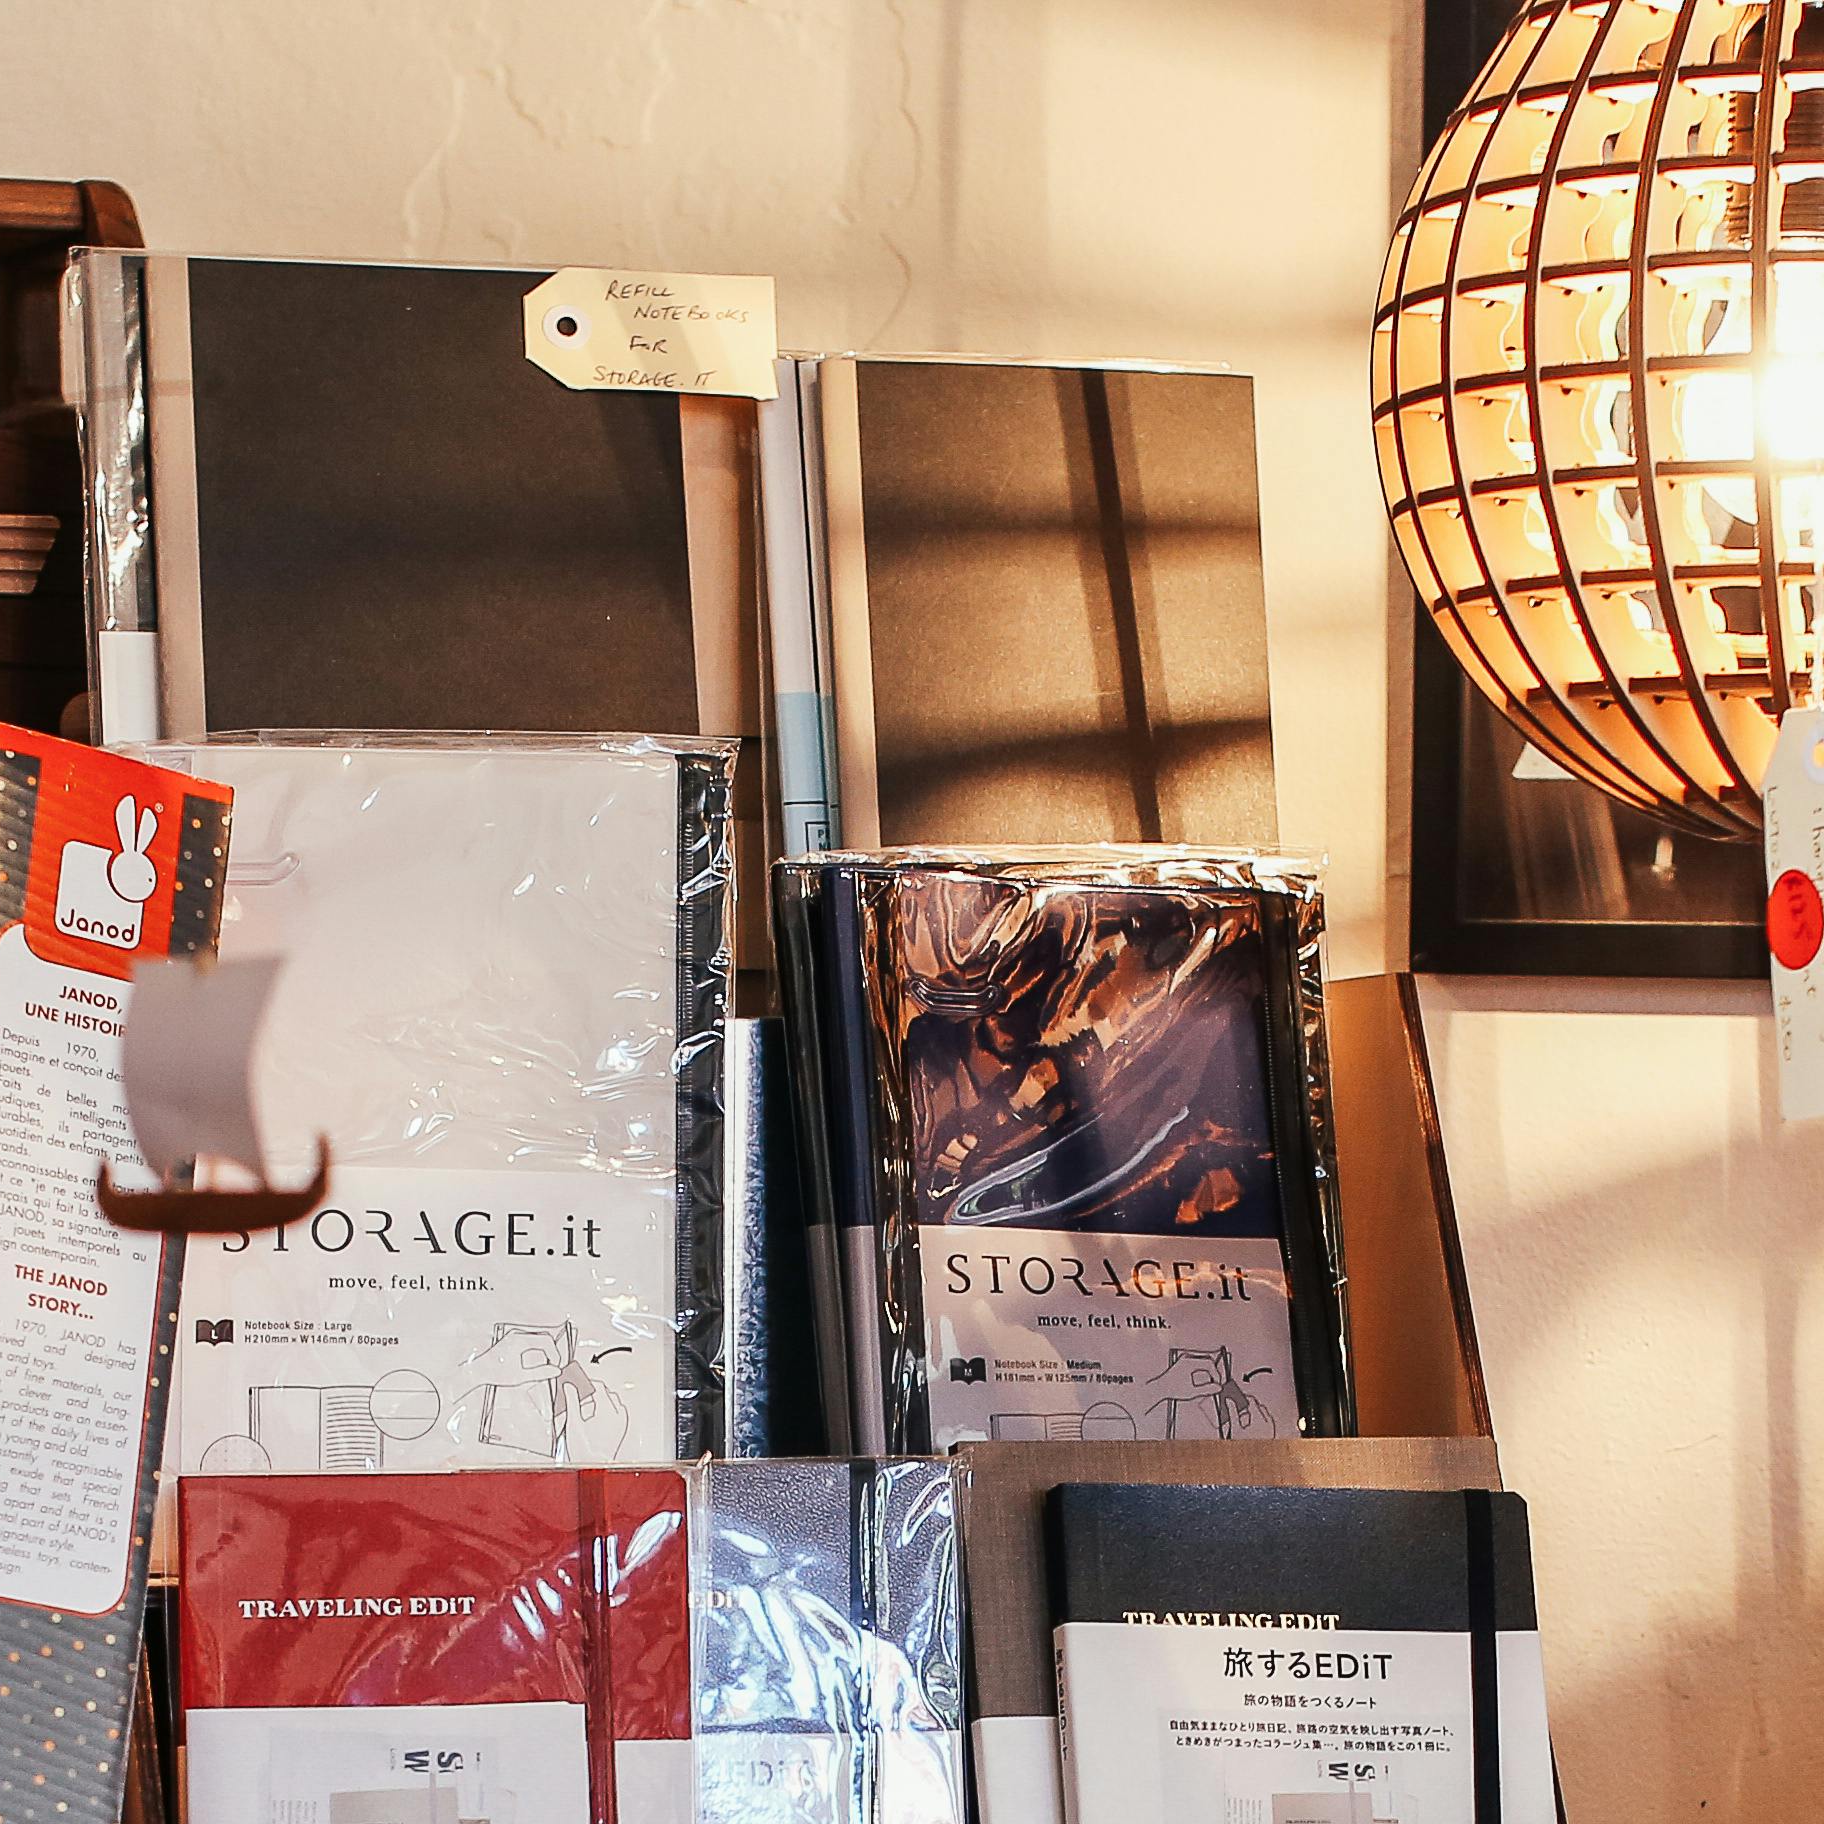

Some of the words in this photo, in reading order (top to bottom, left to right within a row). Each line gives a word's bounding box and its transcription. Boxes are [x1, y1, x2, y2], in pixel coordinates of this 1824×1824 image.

[606, 280, 675, 301] REFILL
[629, 336, 667, 353] FOR
[60, 909, 137, 944] Janod
[59, 986, 123, 1015] JANOD,
[25, 1002, 59, 1022] UNE
[64, 1011, 126, 1038] HISTOIR
[2, 1028, 40, 1047] Depuis
[1, 1046, 45, 1064] imagine
[49, 1058, 60, 1067] et
[64, 1061, 103, 1077] conçoit
[37, 1085, 51, 1097] de
[67, 1090, 97, 1108] belles
[69, 1110, 126, 1130] intelligents
[58, 1120, 70, 1133] ils
[83, 1129, 137, 1149] partagent
[47, 1135, 66, 1149] des
[70, 1141, 110, 1160] enfants,
[115, 1152, 144, 1167] petits
[10, 1175, 23, 1185] ce
[53, 1185, 66, 1196] ne
[74, 1189, 95, 1202] sais
[34, 1197, 51, 1210] qui
[57, 1200, 74, 1213] fait
[78, 1205, 88, 1218] la
[0, 1204, 47, 1226] JANOD,
[52, 1218, 64, 1228] sa
[68, 1218, 122, 1241] signature.
[13, 1225, 46, 1240] jouets
[58, 1232, 121, 1257] intemporels
[132, 1251, 147, 1263] au
[20, 1242, 100, 1267] contemporain.
[15, 1264, 44, 1283] THE
[49, 1272, 108, 1296] JANOD
[329, 1274, 383, 1291] move,
[391, 1274, 431, 1292] feel,
[439, 1275, 495, 1292] think.
[946, 1254, 1252, 1301] STORAGE.it
[28, 1293, 94, 1320] STORY...
[244, 1320, 291, 1331] Notebook
[293, 1320, 314, 1330] Size
[324, 1321, 352, 1331] Large
[1037, 1314, 1082, 1328] move,
[1087, 1314, 1121, 1329] feel,
[1126, 1315, 1172, 1329] think.
[60, 1329, 106, 1348] JANOD
[117, 1340, 137, 1355] has
[995, 1359, 1037, 1369] Notebook
[1039, 1359, 1058, 1369] Size
[1066, 1360, 1102, 1370] Medium
[239, 1598, 402, 1620] TRAVELING
[408, 1593, 476, 1618] EDiT
[1224, 1647, 1393, 1679] 旅するEDiT
[1243, 1694, 1377, 1709] 旅の物語をつくるノート
